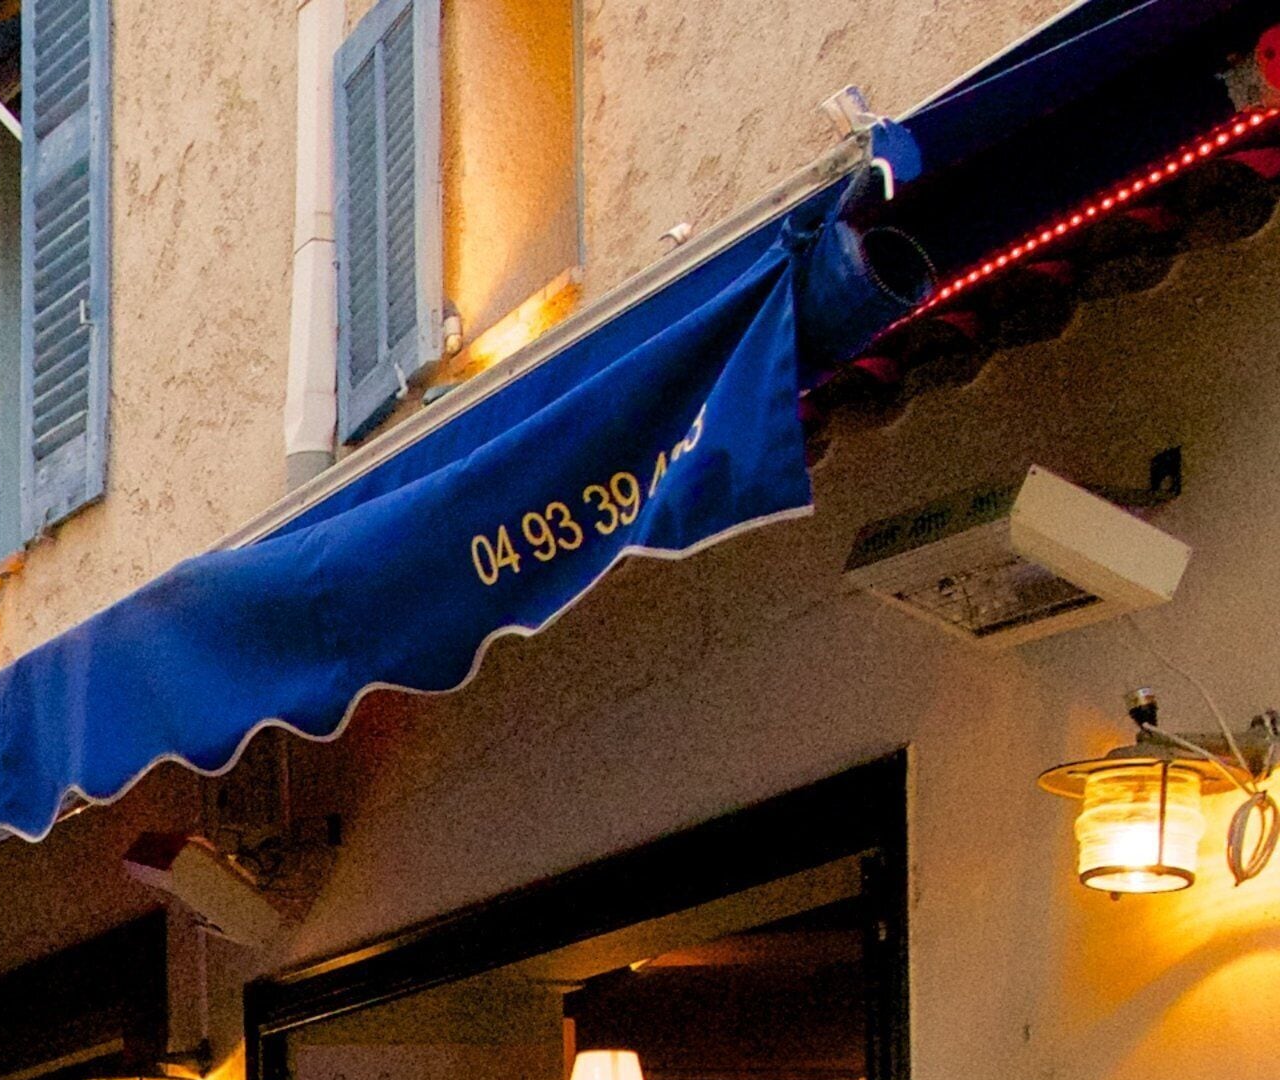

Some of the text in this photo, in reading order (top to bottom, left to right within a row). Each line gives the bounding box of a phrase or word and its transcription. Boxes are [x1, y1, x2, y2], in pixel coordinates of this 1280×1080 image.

[471, 470, 641, 587] 04 93 39
